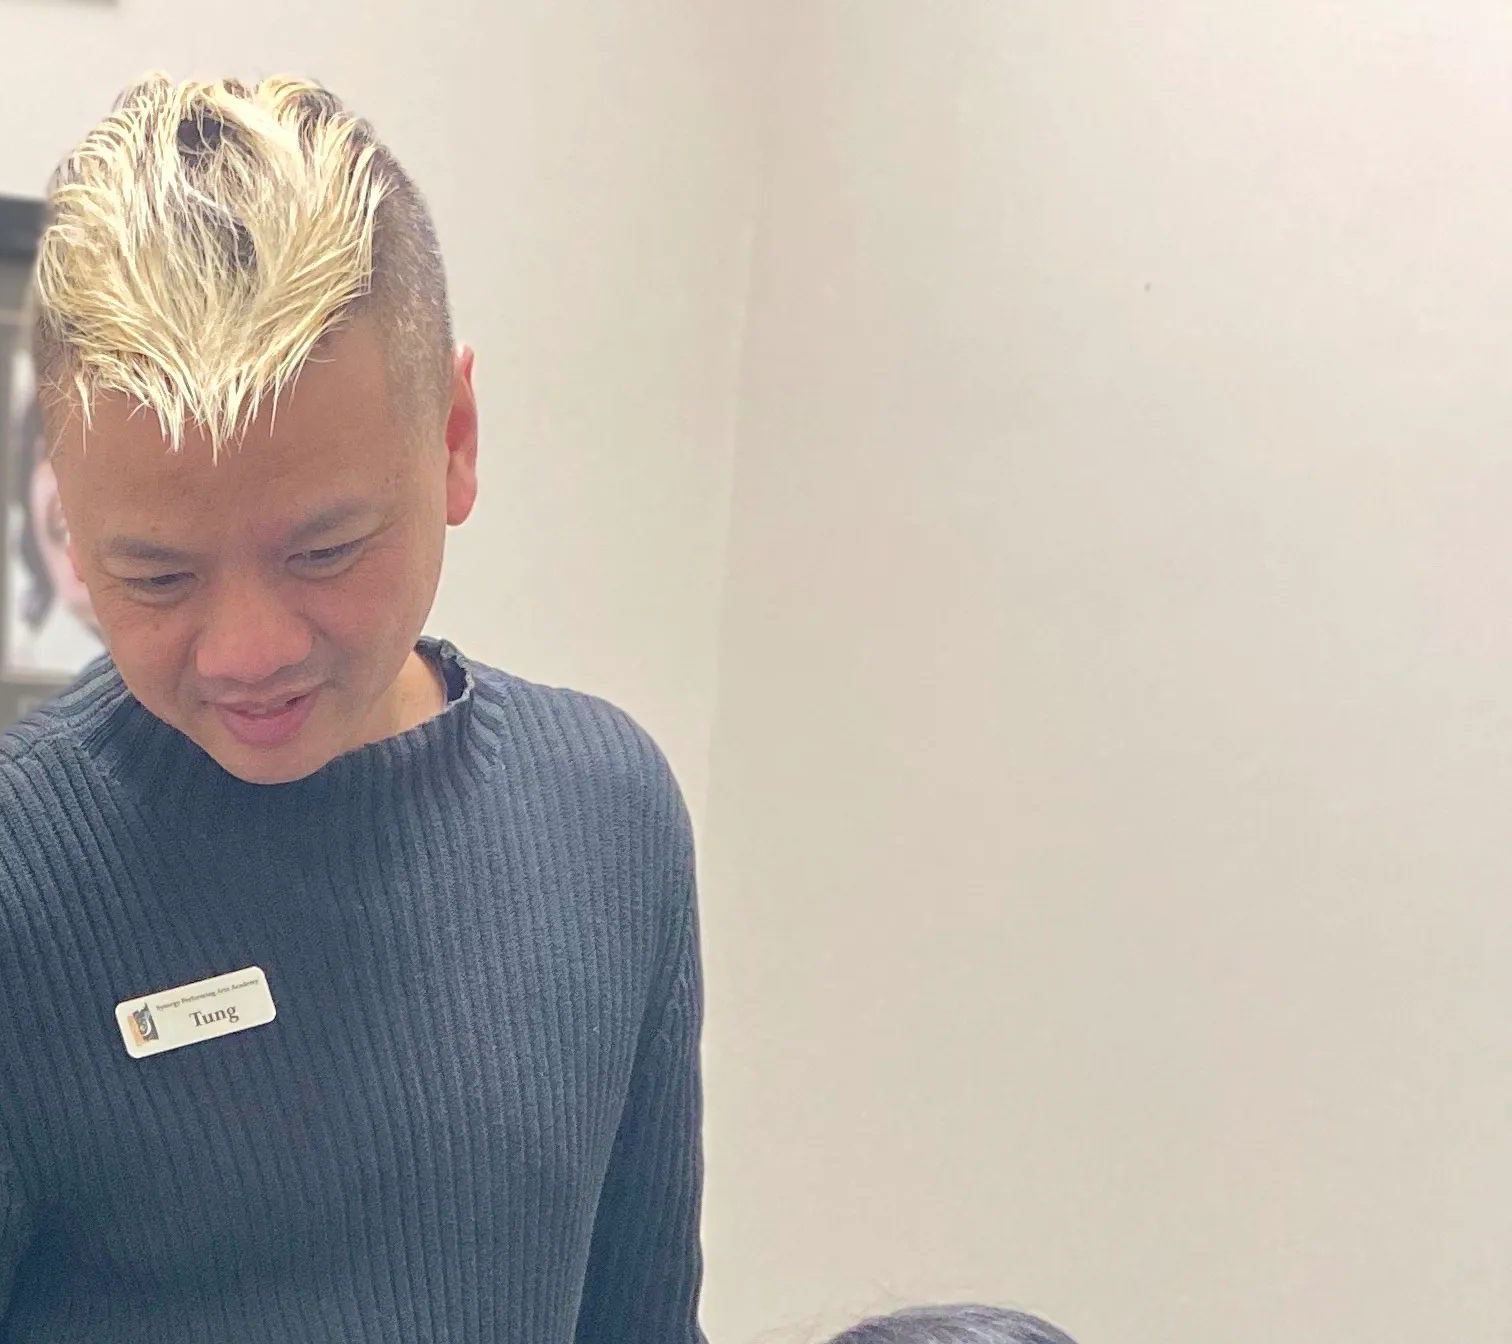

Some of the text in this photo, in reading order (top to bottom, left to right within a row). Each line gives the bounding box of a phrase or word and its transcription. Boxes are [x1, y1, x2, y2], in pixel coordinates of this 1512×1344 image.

[181, 991, 216, 1004] Performing
[231, 979, 259, 991] Academy
[189, 1006, 239, 1027] Tung
